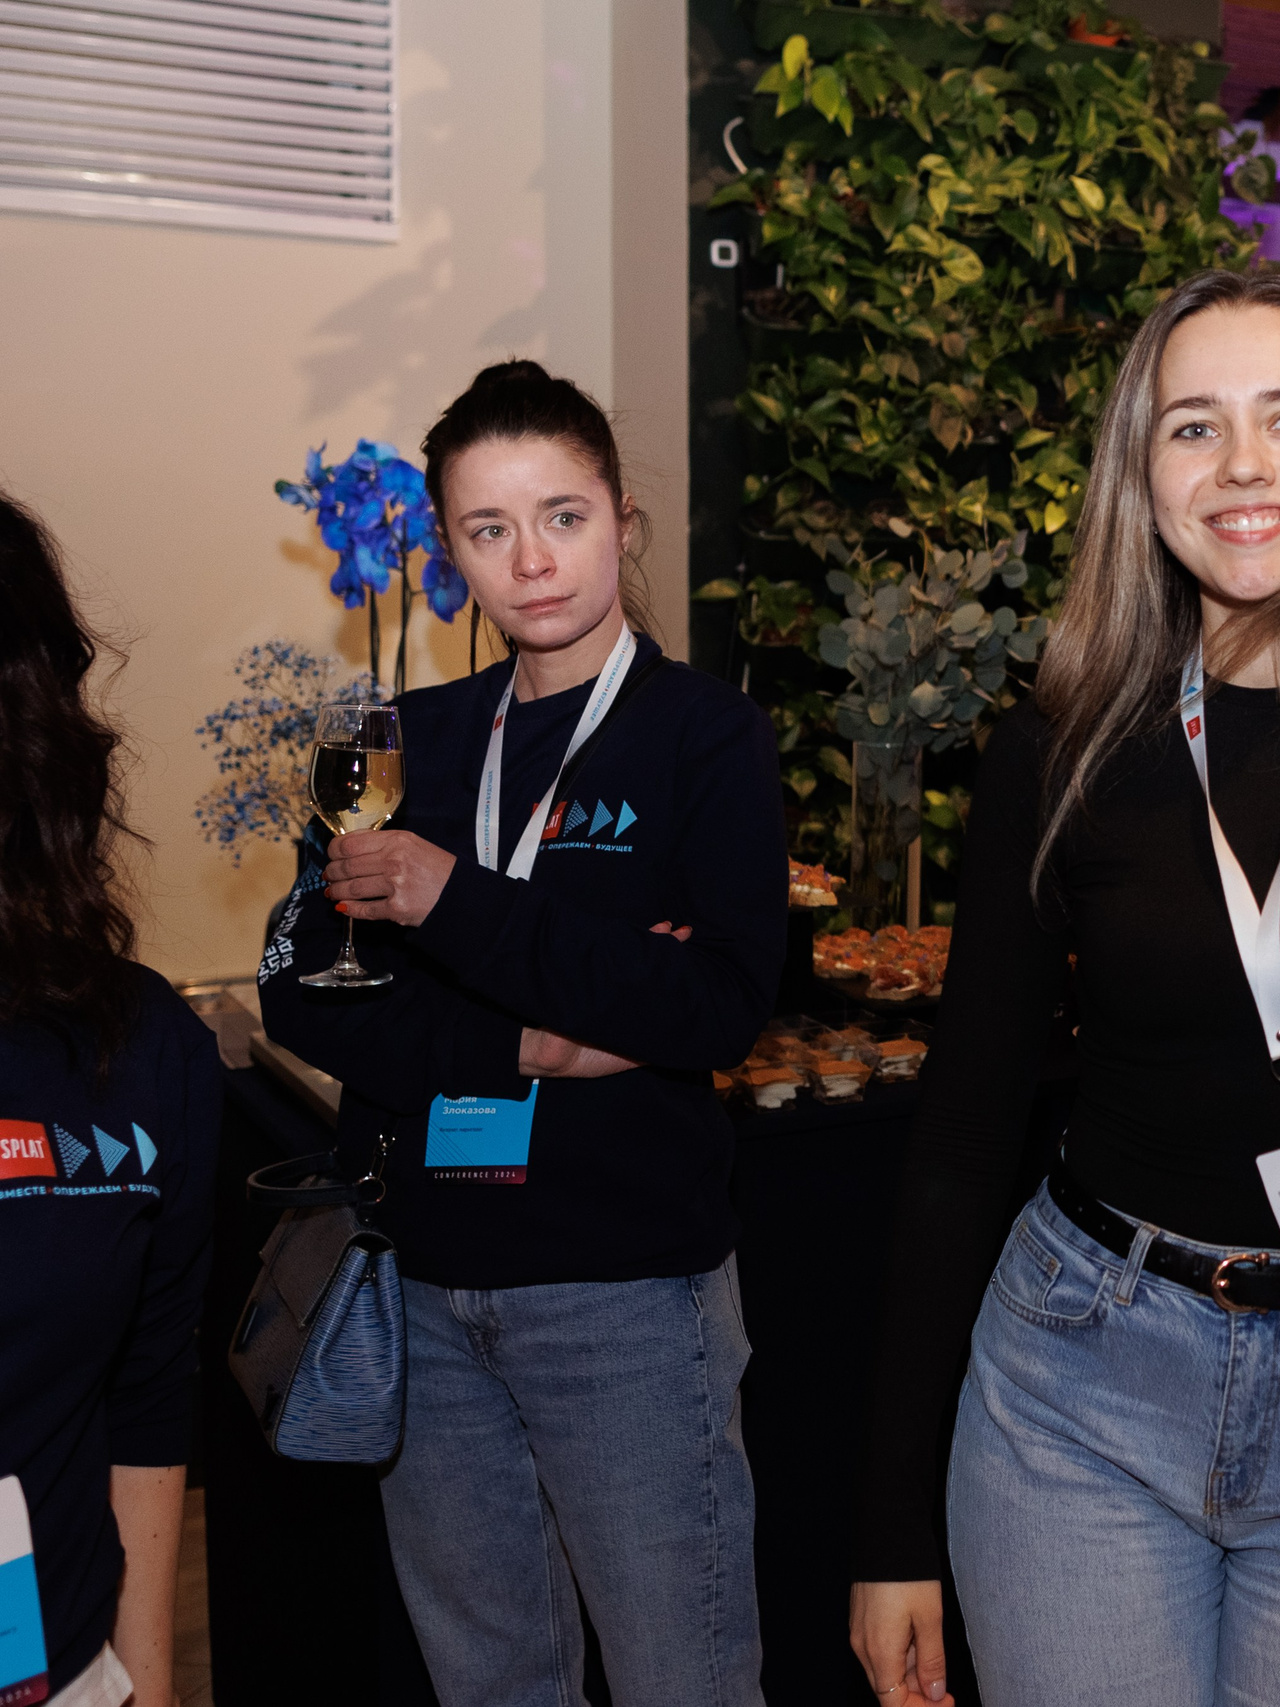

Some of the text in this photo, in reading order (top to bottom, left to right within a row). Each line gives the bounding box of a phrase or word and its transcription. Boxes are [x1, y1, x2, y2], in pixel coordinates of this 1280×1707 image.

[547, 841, 591, 851] ОПЕРЕЖАЕМ
[595, 843, 633, 853] БУДУЩЕЕ
[442, 1106, 497, 1115] Злоказова
[0, 1138, 45, 1159] SPLAT
[434, 1171, 516, 1179] CONFERENCE 2024
[53, 1185, 122, 1196] ОПЕРЕЖАЕМ
